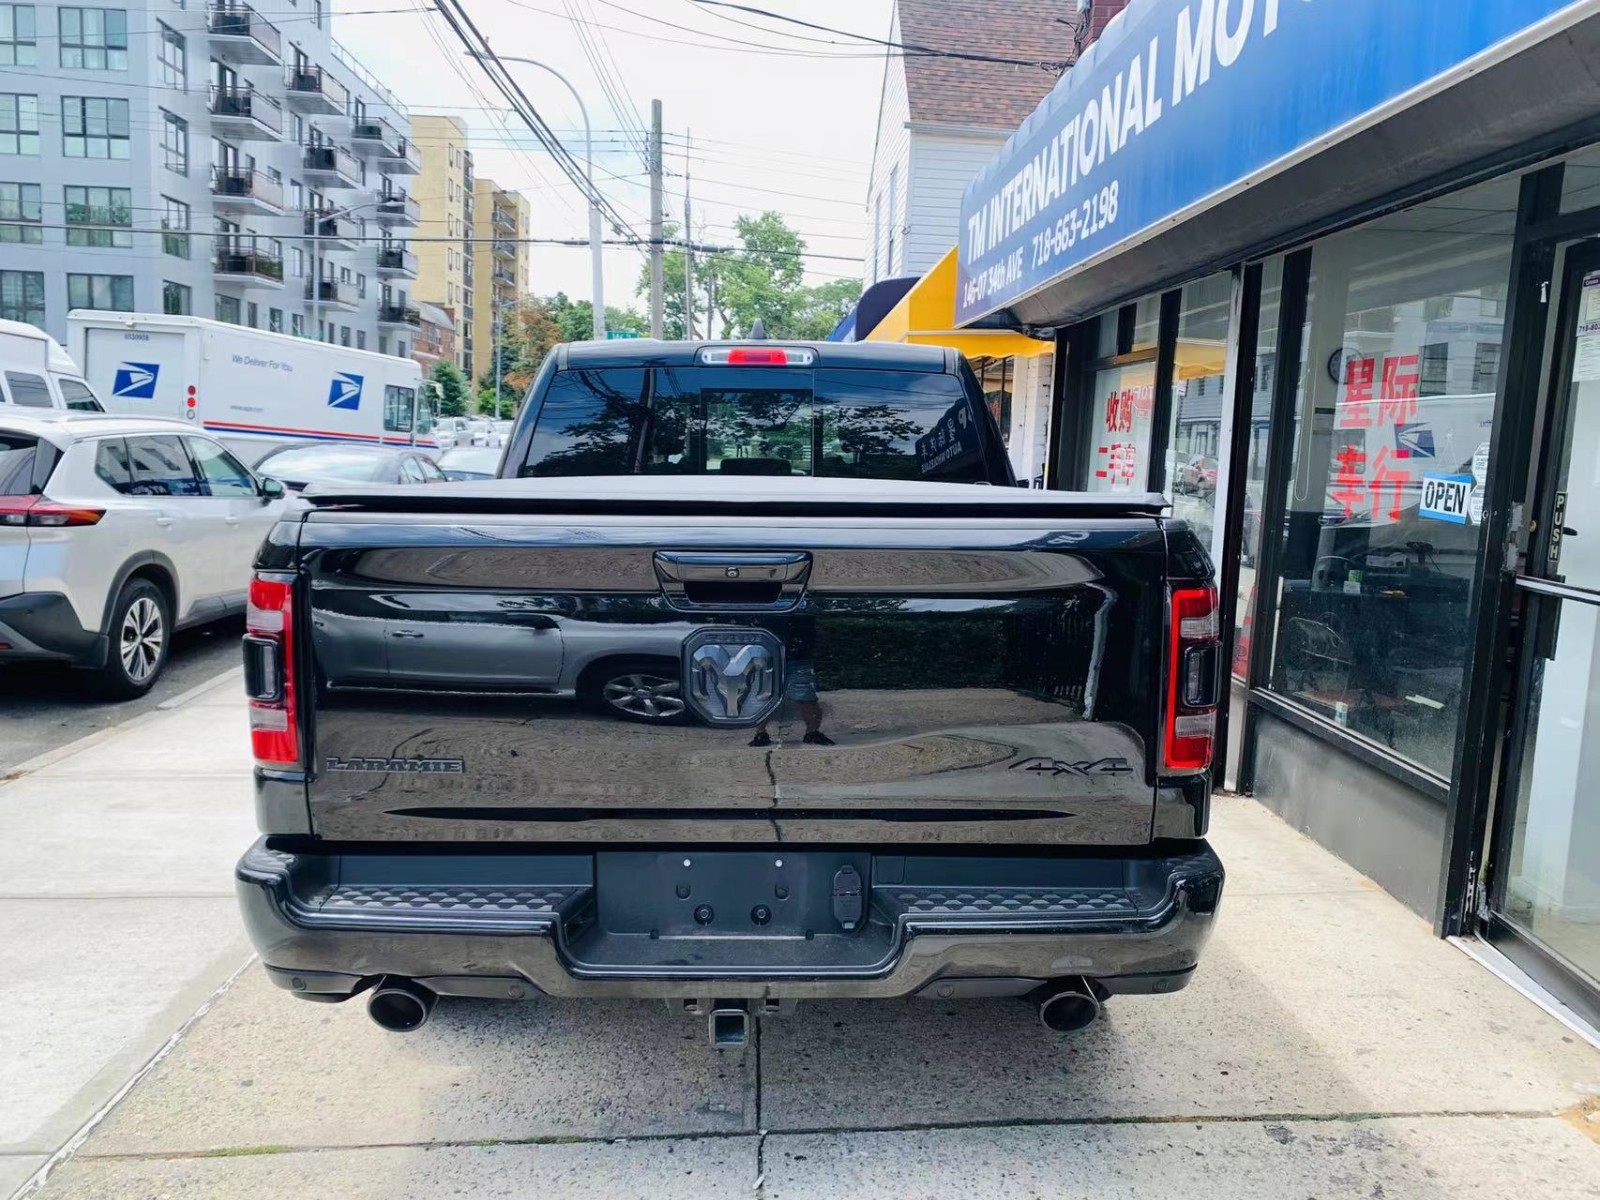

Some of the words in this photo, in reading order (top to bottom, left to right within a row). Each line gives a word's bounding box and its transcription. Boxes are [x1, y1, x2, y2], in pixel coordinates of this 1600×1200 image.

[967, 204, 987, 266] TM
[988, 35, 1162, 250] INTERNATIONAL
[987, 258, 1006, 296] 34th
[1006, 245, 1024, 285] AVE
[1031, 179, 1119, 270] 718-663-2198
[232, 353, 243, 364] We
[243, 355, 268, 368] Deliver
[268, 359, 280, 370] For
[1339, 354, 1419, 428] 星际
[1424, 481, 1466, 515] OPEN
[1549, 495, 1565, 559] PUSH
[326, 757, 464, 774] LARAMIE
